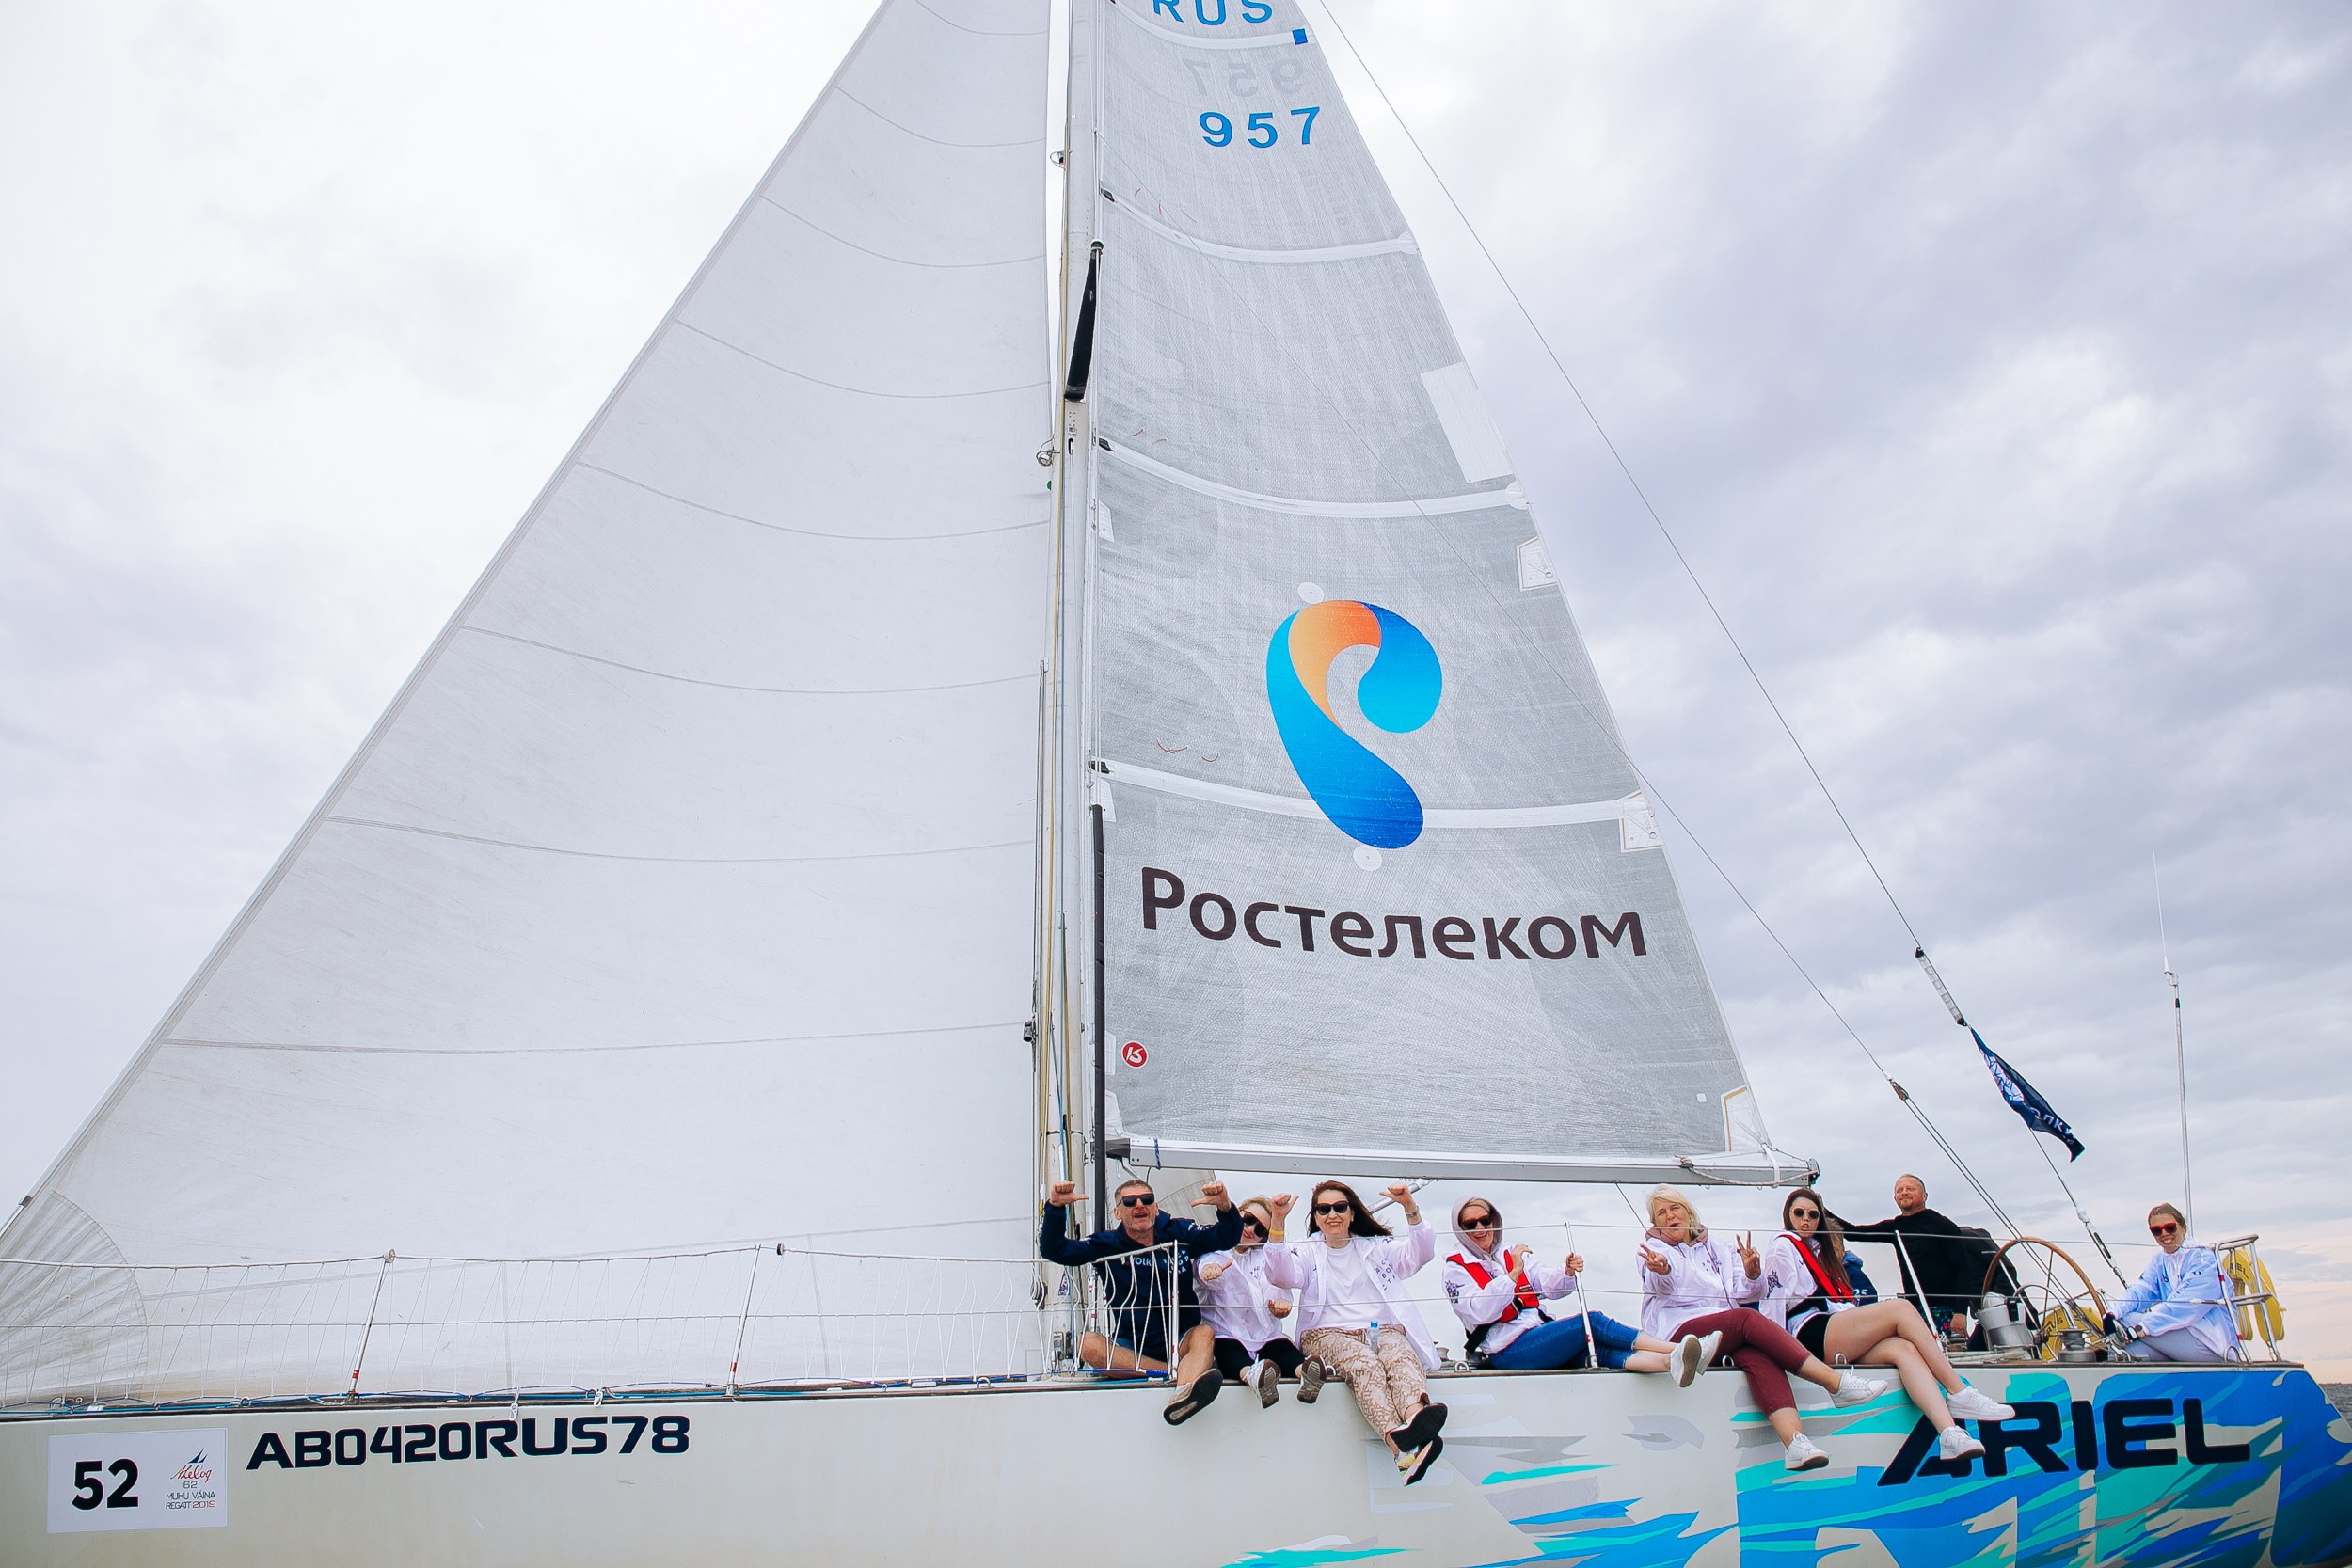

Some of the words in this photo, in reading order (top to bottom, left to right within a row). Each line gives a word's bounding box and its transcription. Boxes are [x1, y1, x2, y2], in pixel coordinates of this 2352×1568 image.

[1152, 0, 1273, 25] RUS
[1199, 106, 1320, 148] 957
[1141, 866, 1647, 960] Ростелеком
[72, 1458, 139, 1511] 52
[165, 1492, 189, 1500] MUHU
[191, 1489, 216, 1499] VÄINA
[192, 1500, 216, 1509] 2019
